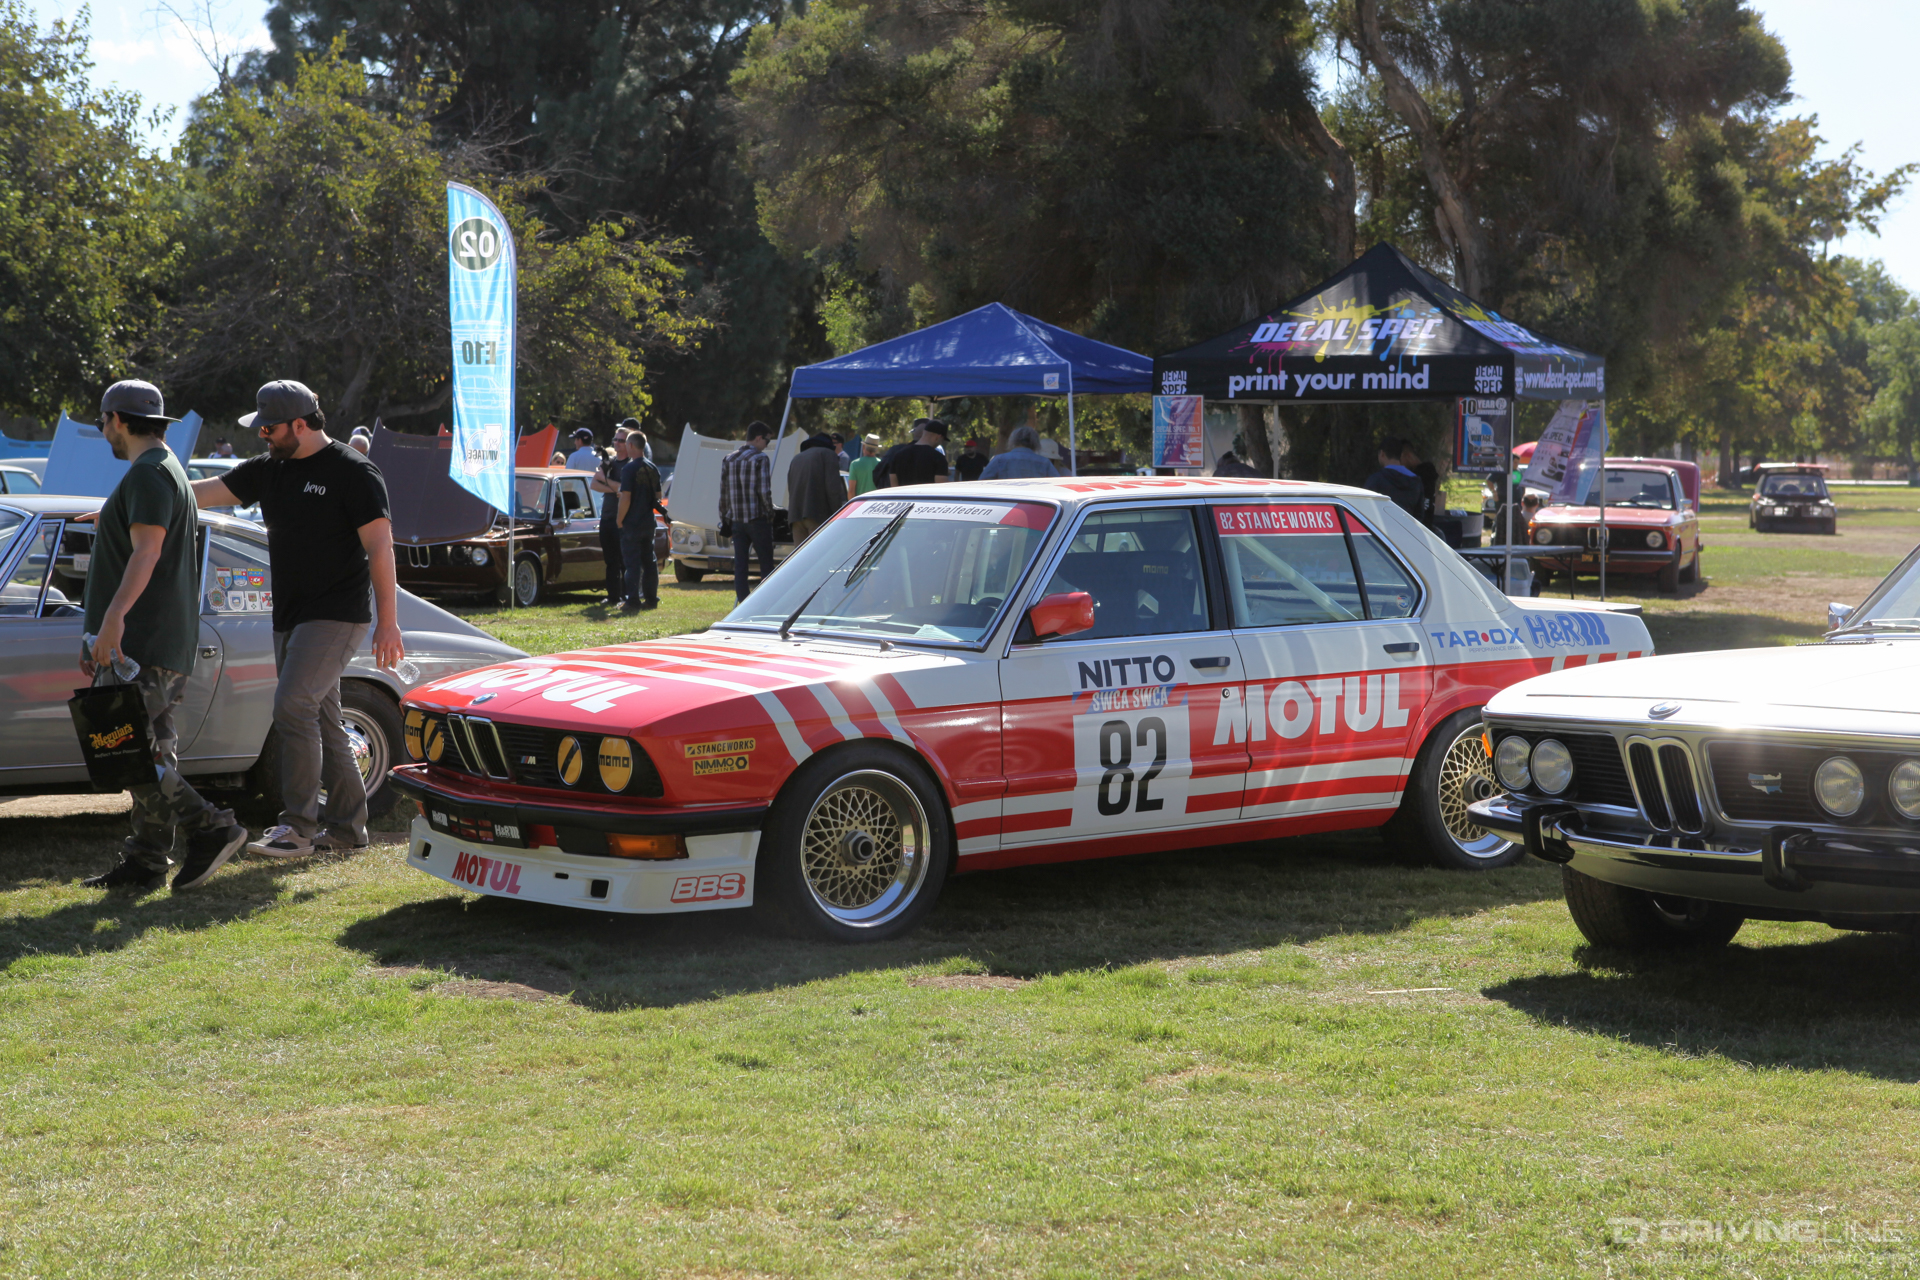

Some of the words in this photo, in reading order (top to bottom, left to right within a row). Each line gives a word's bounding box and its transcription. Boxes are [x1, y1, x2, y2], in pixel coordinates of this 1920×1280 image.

[1250, 319, 1348, 343] DECAL
[1358, 319, 1442, 340] SPEC
[1162, 371, 1187, 382] DECAL
[1229, 367, 1288, 398] print
[1294, 372, 1355, 397] your
[1362, 364, 1430, 389] mind
[1475, 366, 1503, 377] DECAL
[1524, 364, 1596, 394] www.decal-spec.com
[1474, 379, 1502, 393] SPEC
[1460, 398, 1477, 415] 10
[1478, 399, 1495, 409] YEAR
[914, 505, 993, 516] spezialfedern
[1219, 512, 1235, 529] 82
[1237, 512, 1334, 529] STANCEWORKS
[1143, 565, 1168, 574] momo
[1078, 655, 1175, 689] NITTO
[427, 668, 650, 713] MOTUL
[1092, 690, 1129, 711] SWCA
[1132, 687, 1168, 708] SWCA
[1213, 673, 1409, 745] MOTUL
[88, 723, 134, 749] Meguiar's
[697, 740, 754, 754] STANCEWORKS
[599, 755, 630, 768] momo
[695, 757, 734, 770] NIMMO
[1098, 717, 1167, 816] 82
[452, 852, 521, 894] MOTUL
[670, 873, 746, 903] BBS
